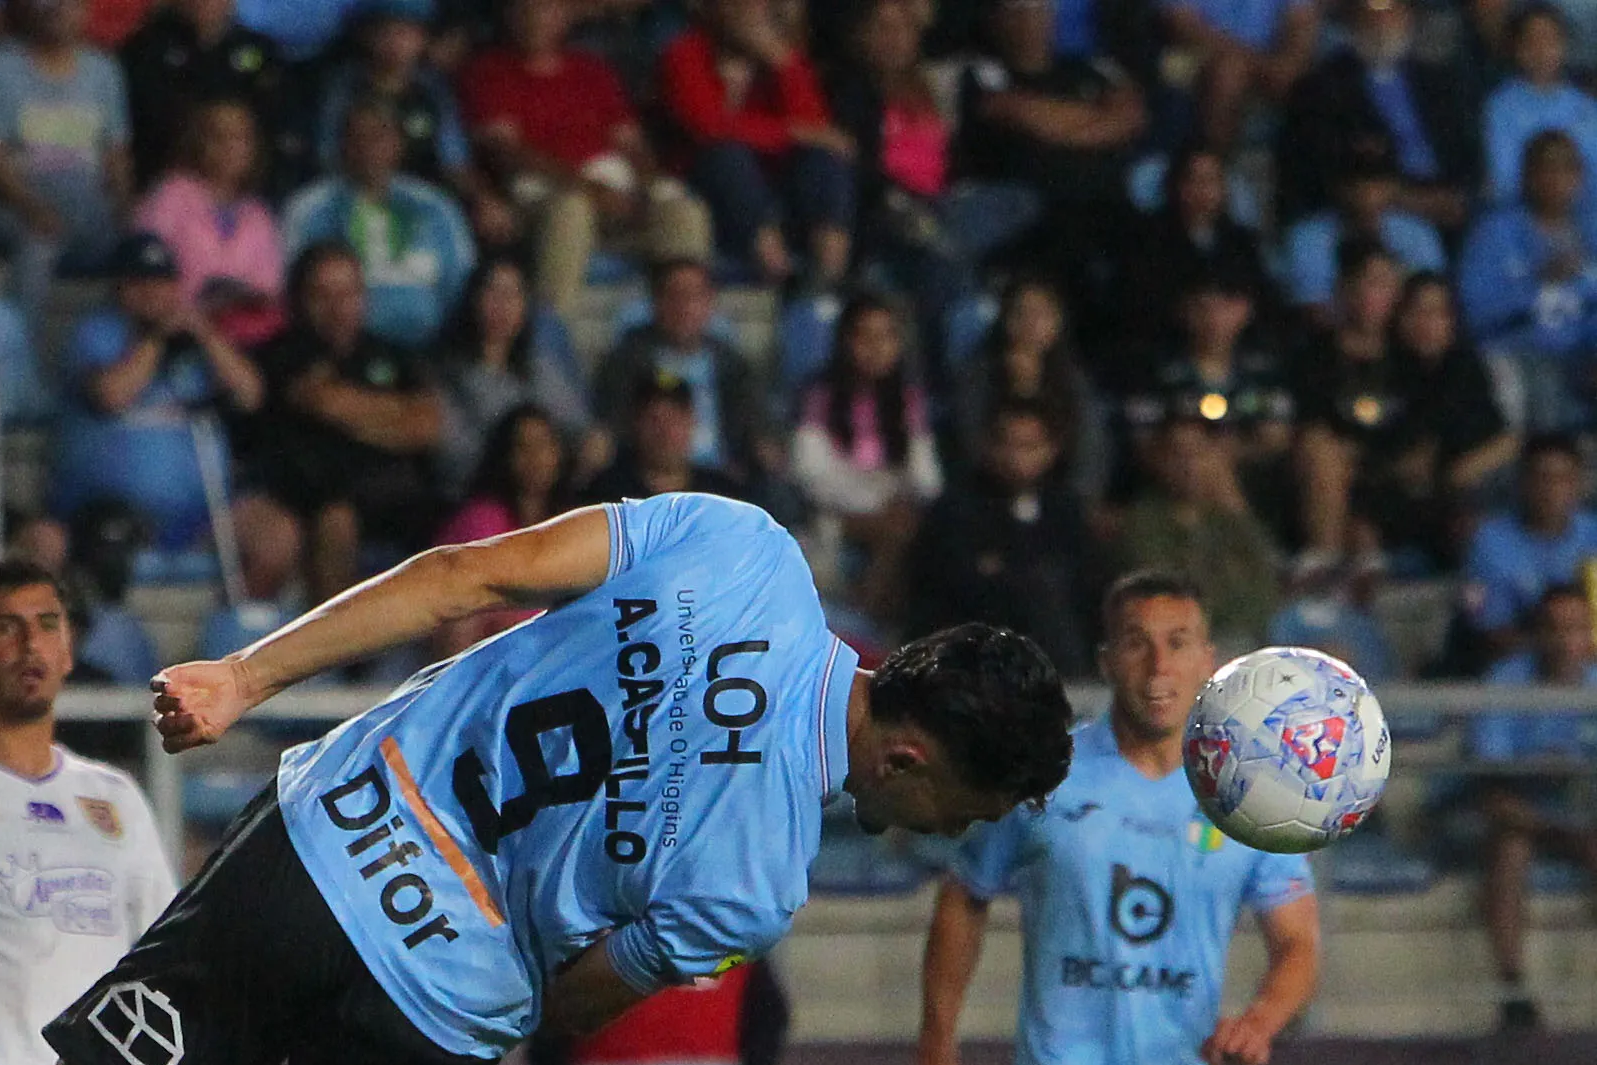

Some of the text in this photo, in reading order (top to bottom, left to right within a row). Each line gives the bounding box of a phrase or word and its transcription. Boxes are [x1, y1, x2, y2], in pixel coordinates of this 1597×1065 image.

[452, 687, 613, 856] 9
[668, 705, 690, 733] de
[319, 765, 459, 951] Difor
[661, 737, 689, 849] O'Higgins
